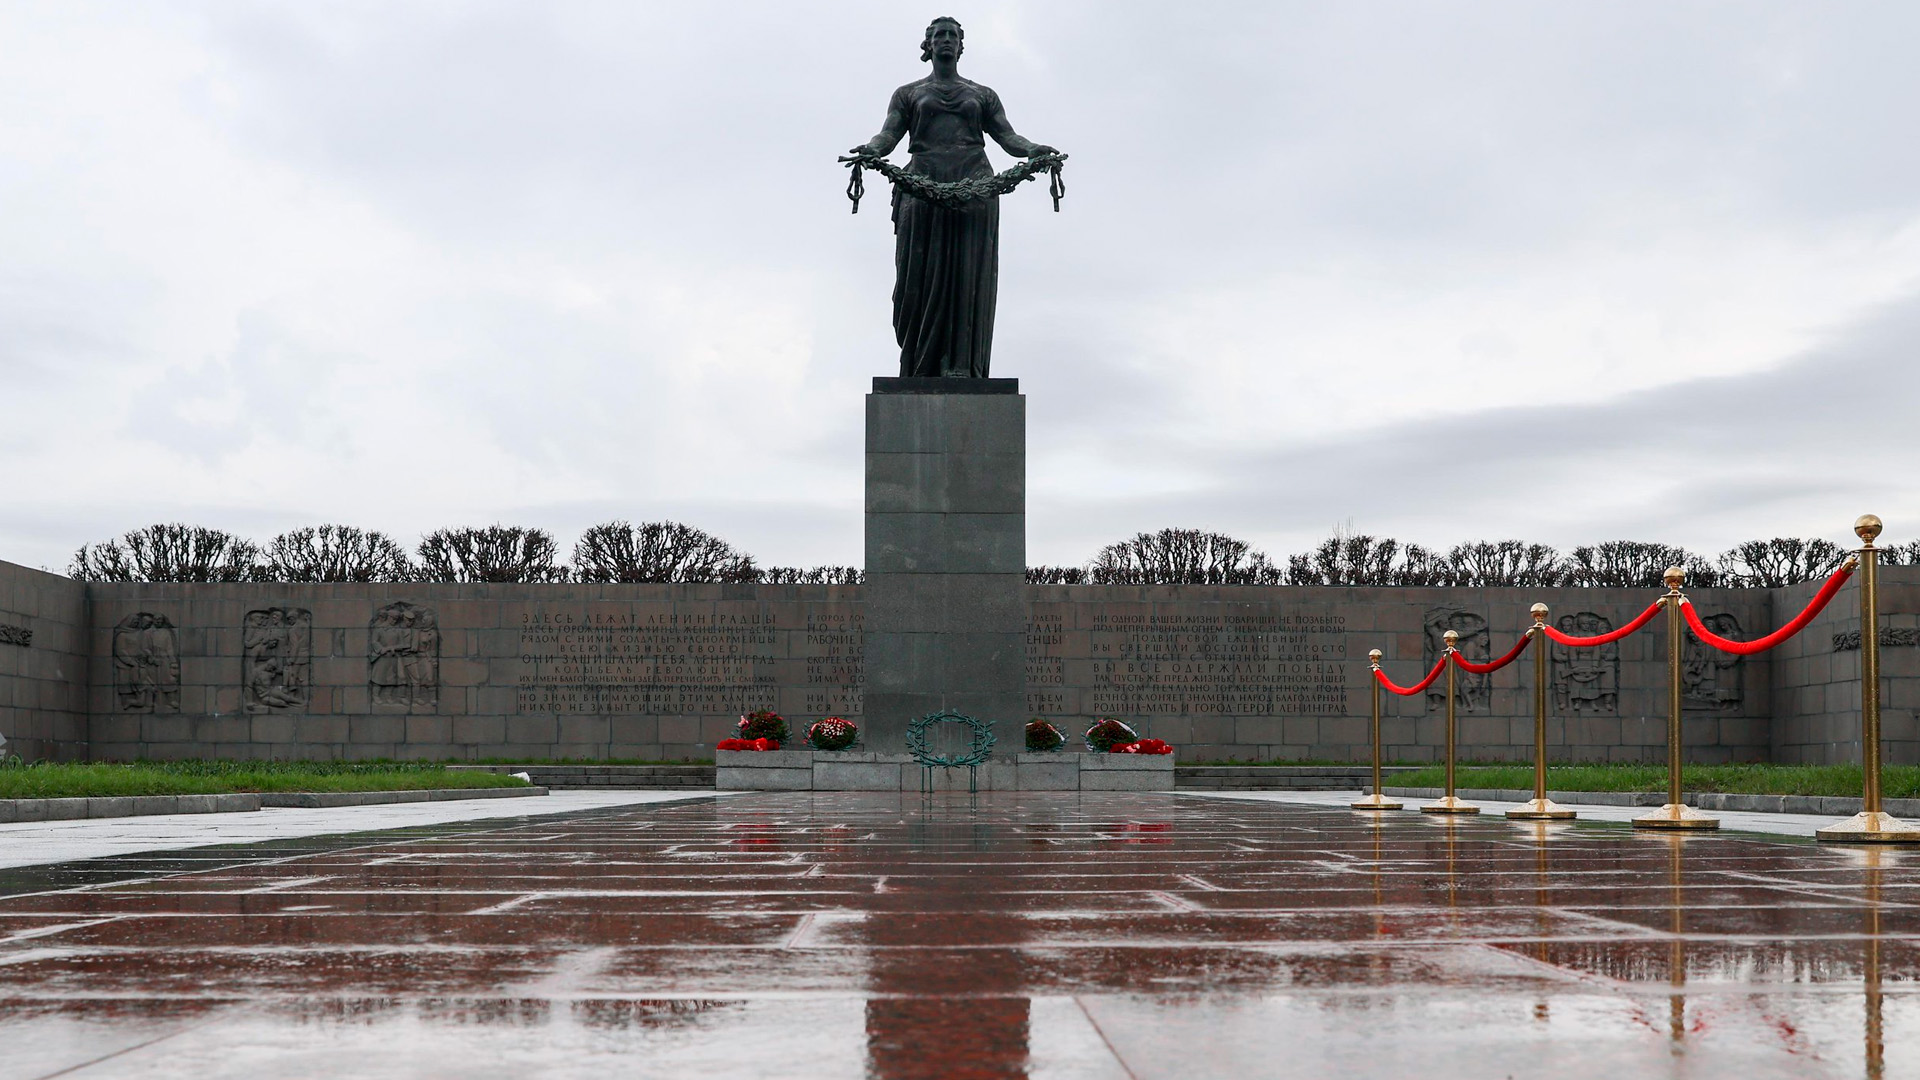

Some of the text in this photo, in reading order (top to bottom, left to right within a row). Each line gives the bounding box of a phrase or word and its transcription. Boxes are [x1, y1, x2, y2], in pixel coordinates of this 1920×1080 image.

[522, 614, 776, 624] ЗДЕСЬ ЛЕЖАТ ЛЕНИНГРАДЦЫ
[1094, 615, 1108, 624] НИ
[1280, 615, 1292, 624] НЕ
[522, 625, 554, 634] ЗДЕСЬ
[558, 625, 615, 634] ГОРОЖАНЕ
[808, 623, 828, 633] НО
[1093, 625, 1113, 633] ПОД
[1116, 625, 1188, 633] НЕПРЕРЫВНЫМ
[1191, 625, 1223, 633] ОГНЕМ
[1302, 625, 1308, 633] И
[1311, 625, 1317, 633] С
[1320, 625, 1346, 633] ВОДЫ
[521, 635, 559, 644] РЯДОМ
[565, 635, 572, 644] С
[578, 635, 613, 644] НИМИ
[1132, 635, 1180, 643] ПОДВИГ
[560, 645, 738, 653] ВСЕЮ ЖИЗНЬЮ СВОЕЮ
[1093, 644, 1111, 652] ВЫ
[1119, 644, 1188, 652] СВЕРШАЛИ
[1278, 644, 1285, 652] И
[522, 654, 554, 664] ОНИ
[807, 656, 841, 665] СКОРЕЕ
[1026, 656, 1062, 664] МЕРТИ
[1121, 654, 1128, 662] И
[1136, 654, 1182, 662] ВМЕСТЕ
[807, 666, 823, 674] НЕ
[1094, 664, 1346, 673] ВЫ ВСЕ ОДЕРЖАЛИ ПОБЕДУ
[807, 675, 840, 683] ЗИМА
[1095, 675, 1110, 683] ТАК
[1114, 675, 1144, 683] ПУСТЬ
[1147, 675, 1160, 683] ЖЕ
[1164, 675, 1189, 683] ПРЕД
[1192, 675, 1235, 683] ЖИЗНЬЮ
[1240, 675, 1312, 683] БЕССМЕРТНОЮ
[1094, 684, 1108, 692] НА
[1115, 684, 1145, 692] ЭТОМ
[1316, 684, 1347, 692] ПОЛЕ
[520, 694, 537, 702] НО
[679, 694, 714, 702] ЭТИМ
[807, 694, 824, 703] НИ
[1094, 694, 1128, 702] ВЕЧНО
[1132, 694, 1183, 702] СКЛОНЯЕТ
[1187, 694, 1236, 702] ЗНАМЕНА
[1239, 694, 1272, 702] НАРОД
[520, 704, 562, 712] НИКТО
[570, 704, 585, 712] НЕ
[591, 704, 632, 712] ЗАБЫТ
[639, 704, 646, 712] И
[653, 704, 695, 712] НИЧТО
[702, 704, 717, 712] НЕ
[807, 704, 832, 712] ВСЯ
[1094, 703, 1177, 713] РОДИНА-МАТЬ
[1182, 703, 1189, 713] И
[1280, 703, 1348, 713] ЛЕНИНГРАД
